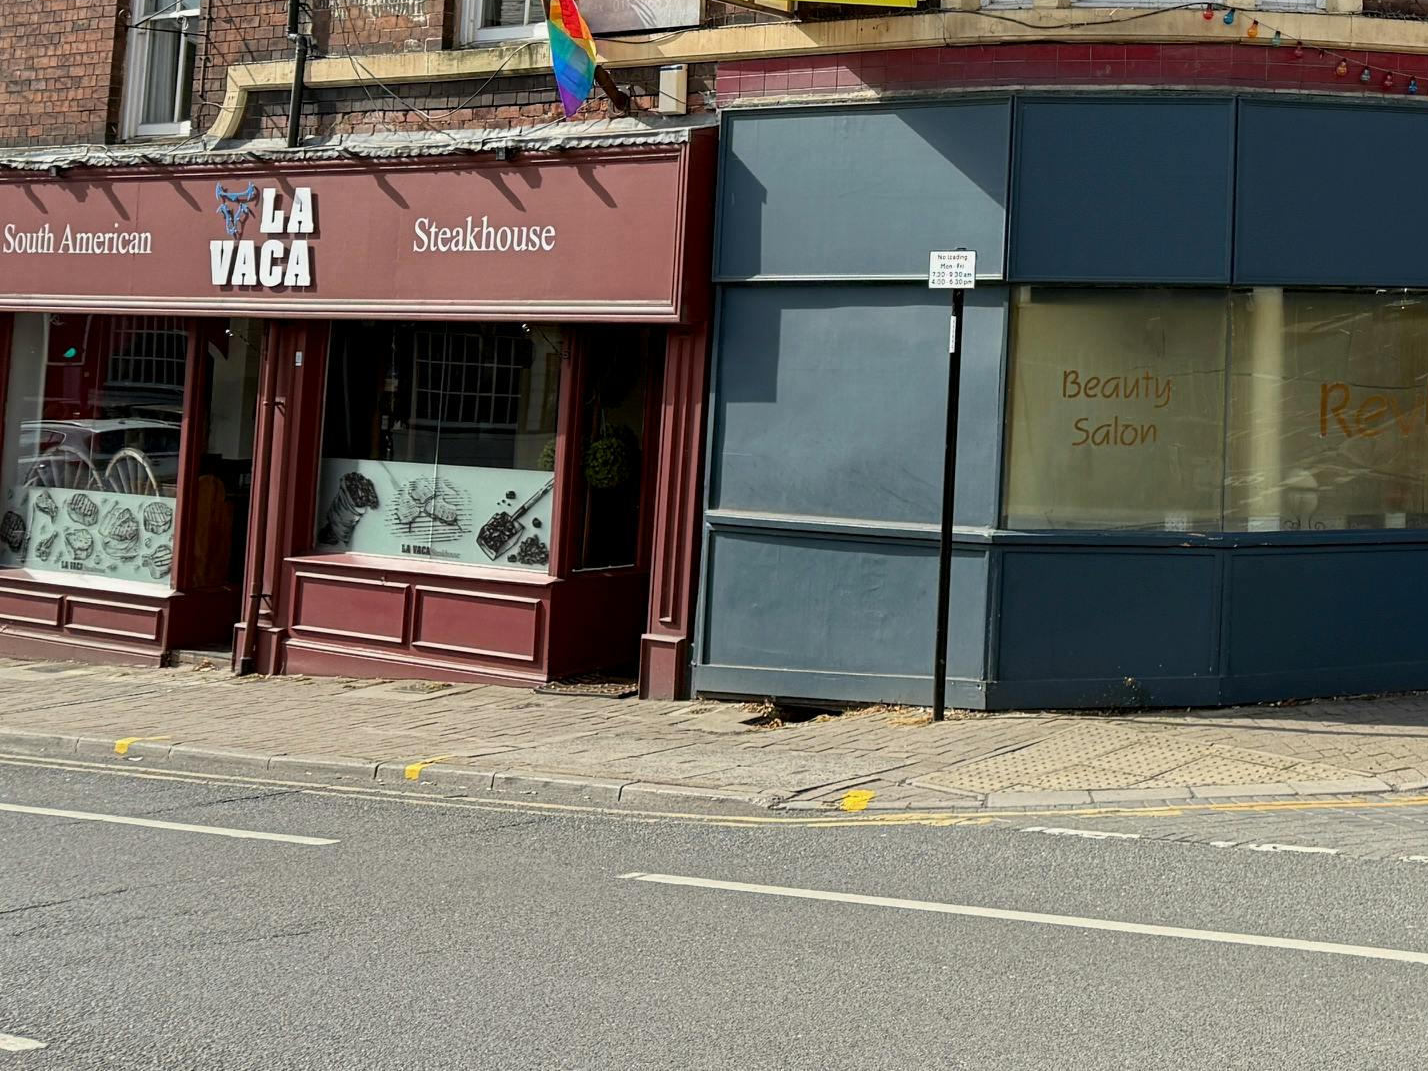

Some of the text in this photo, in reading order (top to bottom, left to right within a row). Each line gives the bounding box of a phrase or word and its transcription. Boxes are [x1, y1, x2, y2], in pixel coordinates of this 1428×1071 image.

[259, 187, 315, 234] LA
[2, 222, 153, 255] South American
[412, 215, 557, 252] Steakhouse
[209, 239, 312, 287] VACA
[1062, 370, 1172, 408] Beauty
[1072, 416, 1158, 447] Salon
[401, 544, 411, 554] LA
[412, 545, 431, 555] VACA
